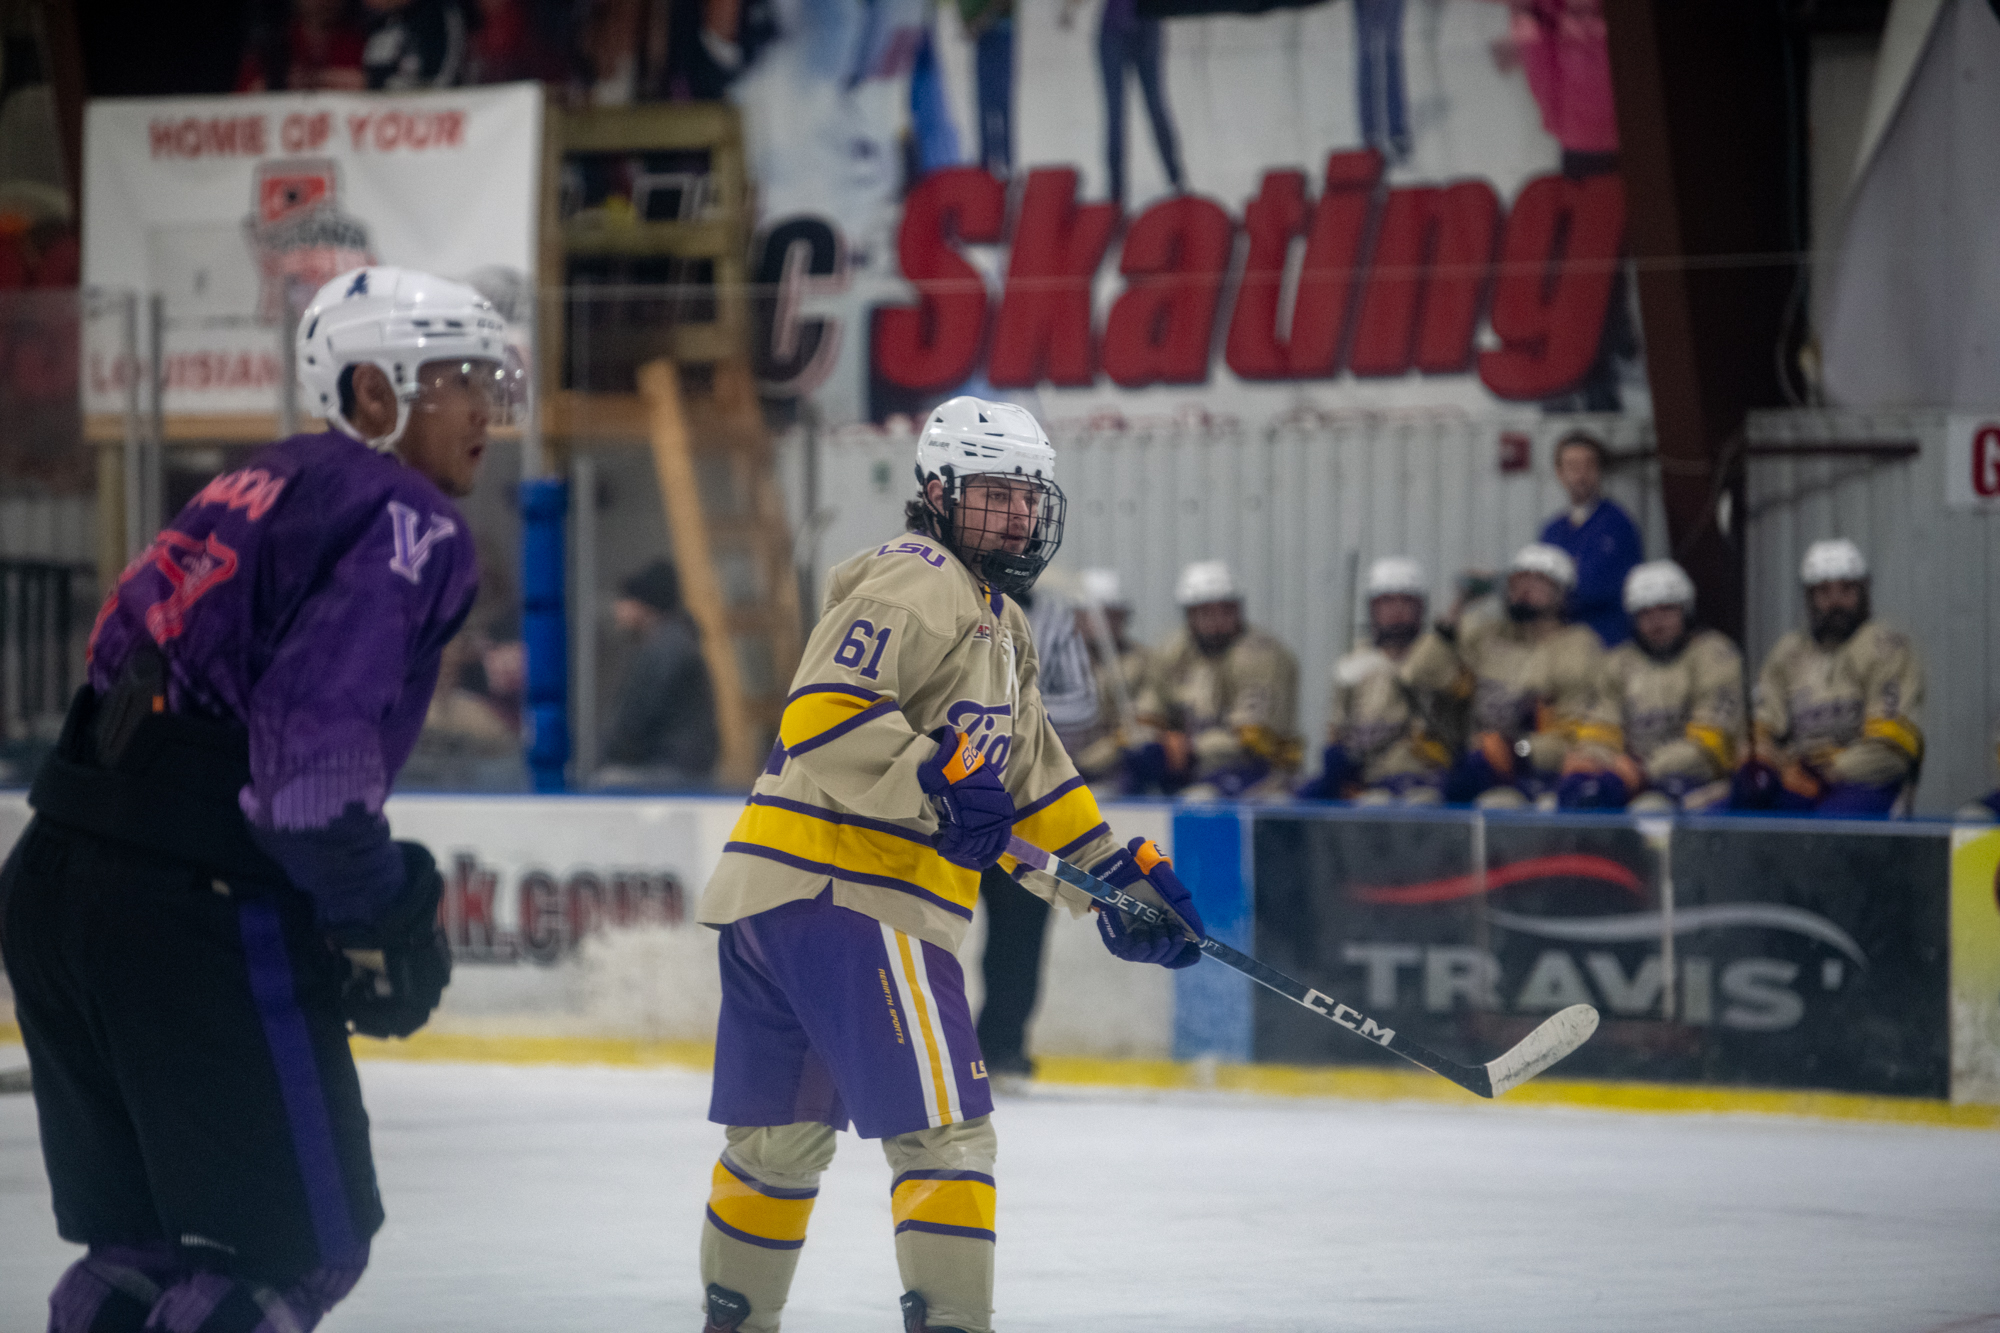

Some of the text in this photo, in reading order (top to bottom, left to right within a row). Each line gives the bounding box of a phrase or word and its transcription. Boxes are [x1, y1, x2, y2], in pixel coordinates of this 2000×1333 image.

[149, 110, 466, 158] HOME OF YOUR
[871, 148, 1628, 399] Skating
[877, 541, 947, 569] LSU
[833, 618, 892, 681] 61
[890, 1008, 904, 1045] SPORTS
[1303, 988, 1396, 1047] CCM
